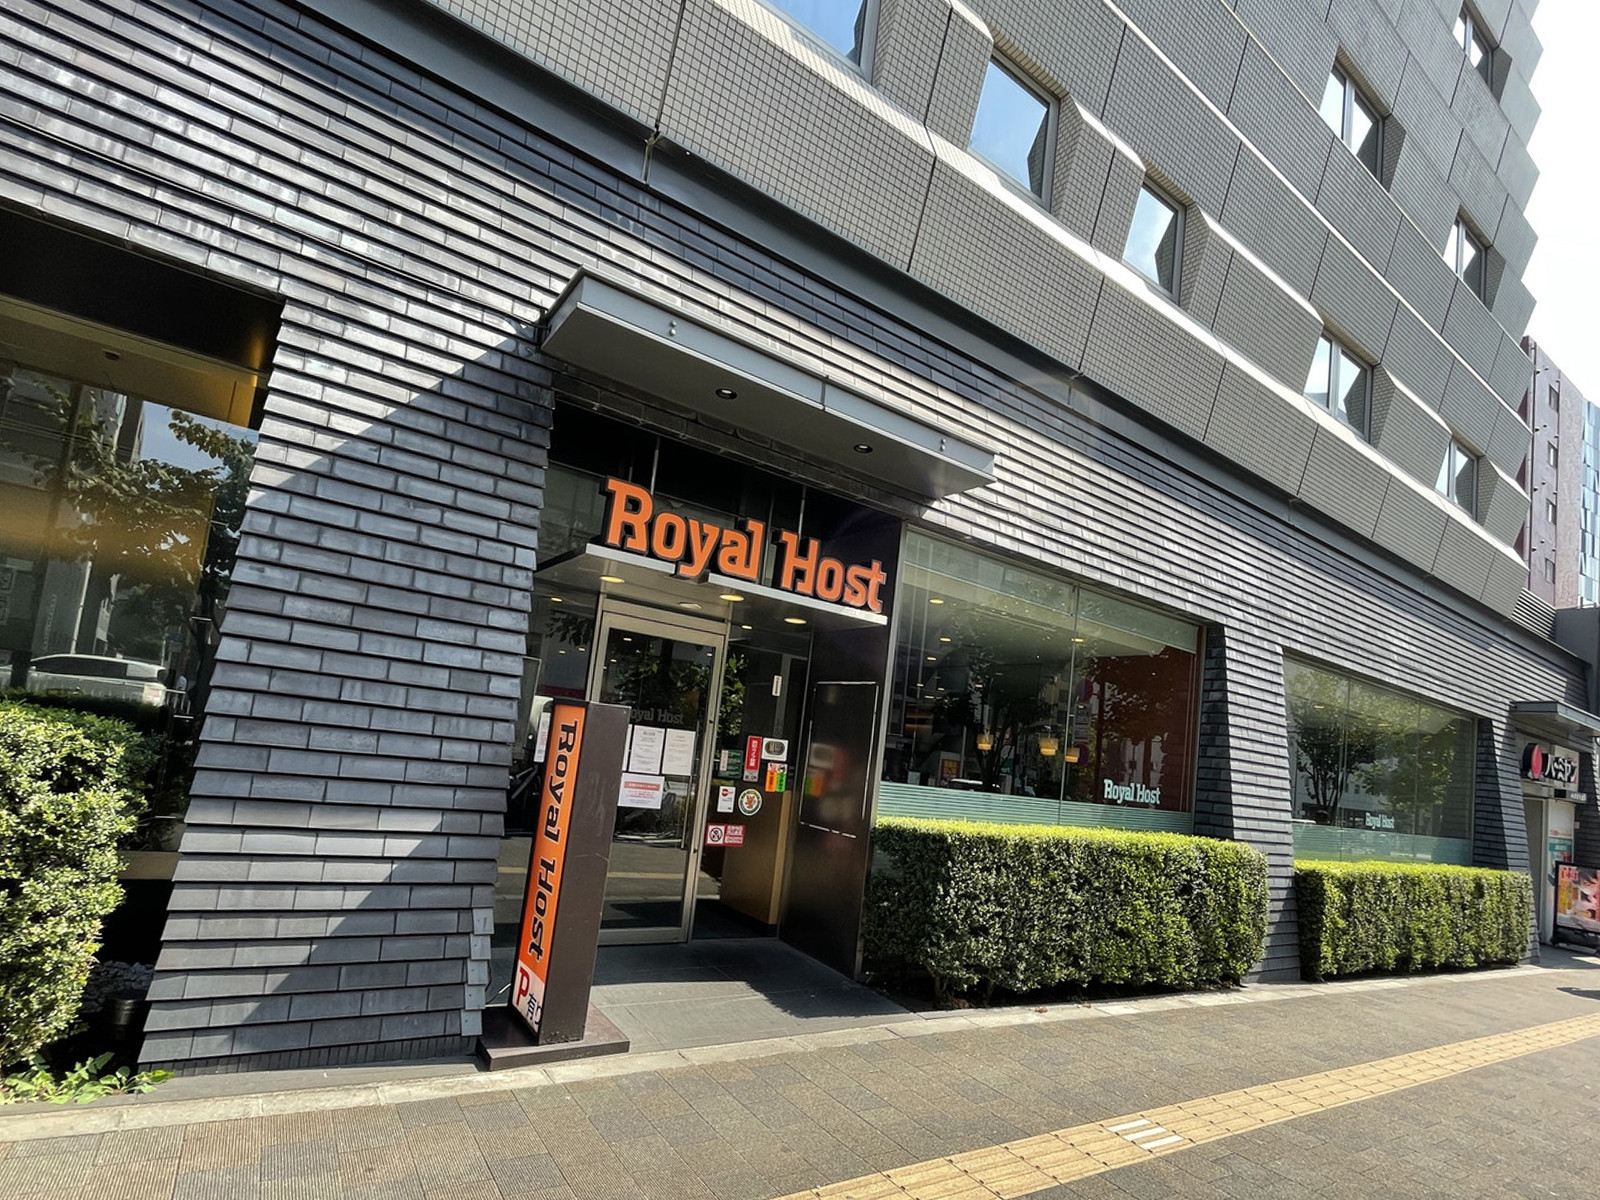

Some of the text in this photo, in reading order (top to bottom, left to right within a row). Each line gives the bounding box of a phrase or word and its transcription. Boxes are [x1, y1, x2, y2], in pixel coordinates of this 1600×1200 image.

[606, 477, 887, 613] Royal Host
[631, 708, 684, 724] oyal Host
[1103, 778, 1161, 805] Royal Host
[1365, 812, 1395, 830] Royal Host
[527, 719, 578, 961] Royal Host
[516, 966, 530, 1006] P
